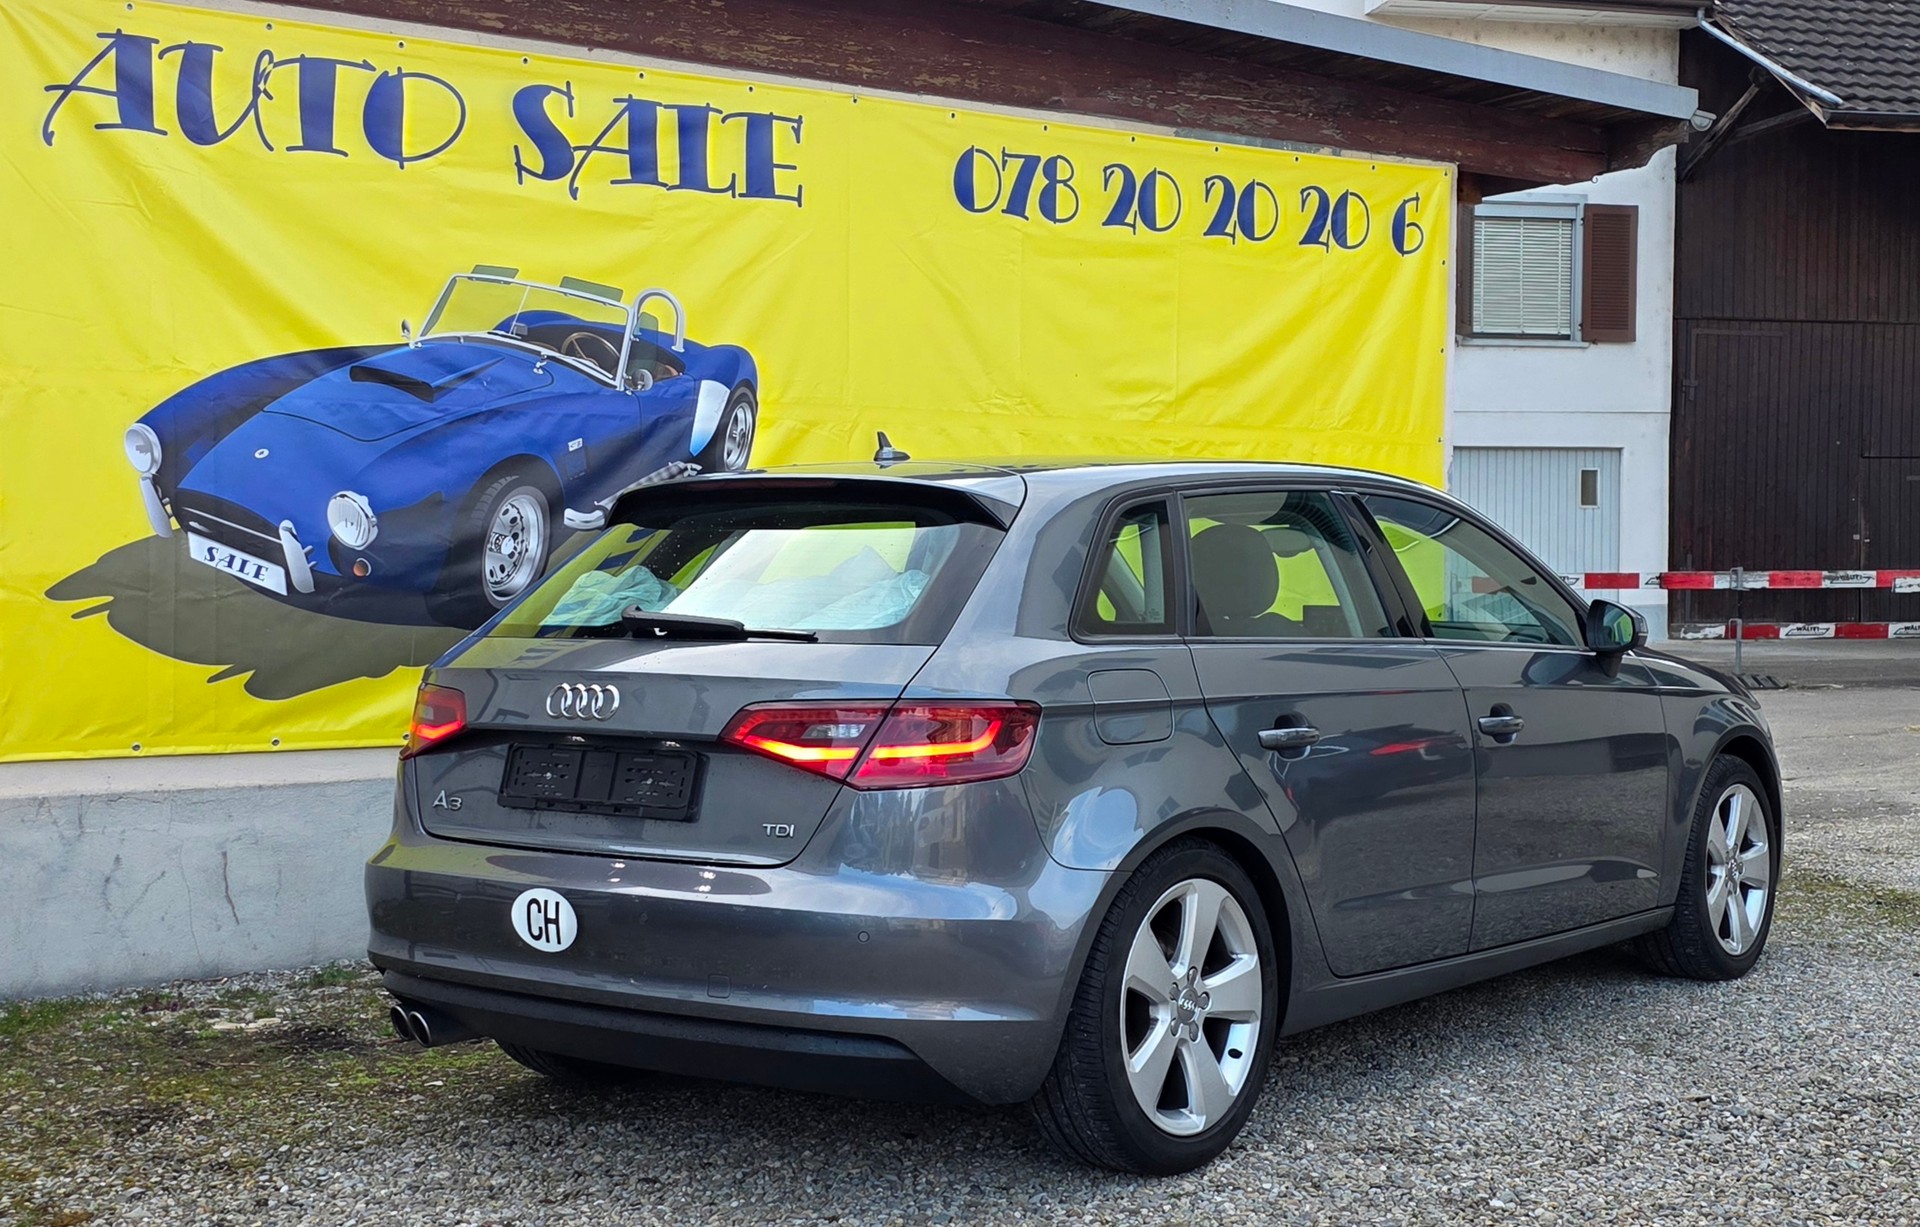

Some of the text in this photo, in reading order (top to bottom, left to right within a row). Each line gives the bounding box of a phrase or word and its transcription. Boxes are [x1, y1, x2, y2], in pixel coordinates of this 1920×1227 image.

[43, 27, 804, 208] AUTO SALE
[953, 145, 1425, 257] 078 20 20 20 6
[204, 545, 269, 582] SALE
[432, 789, 463, 811] A3
[762, 822, 796, 839] TDI
[525, 897, 562, 945] CH
